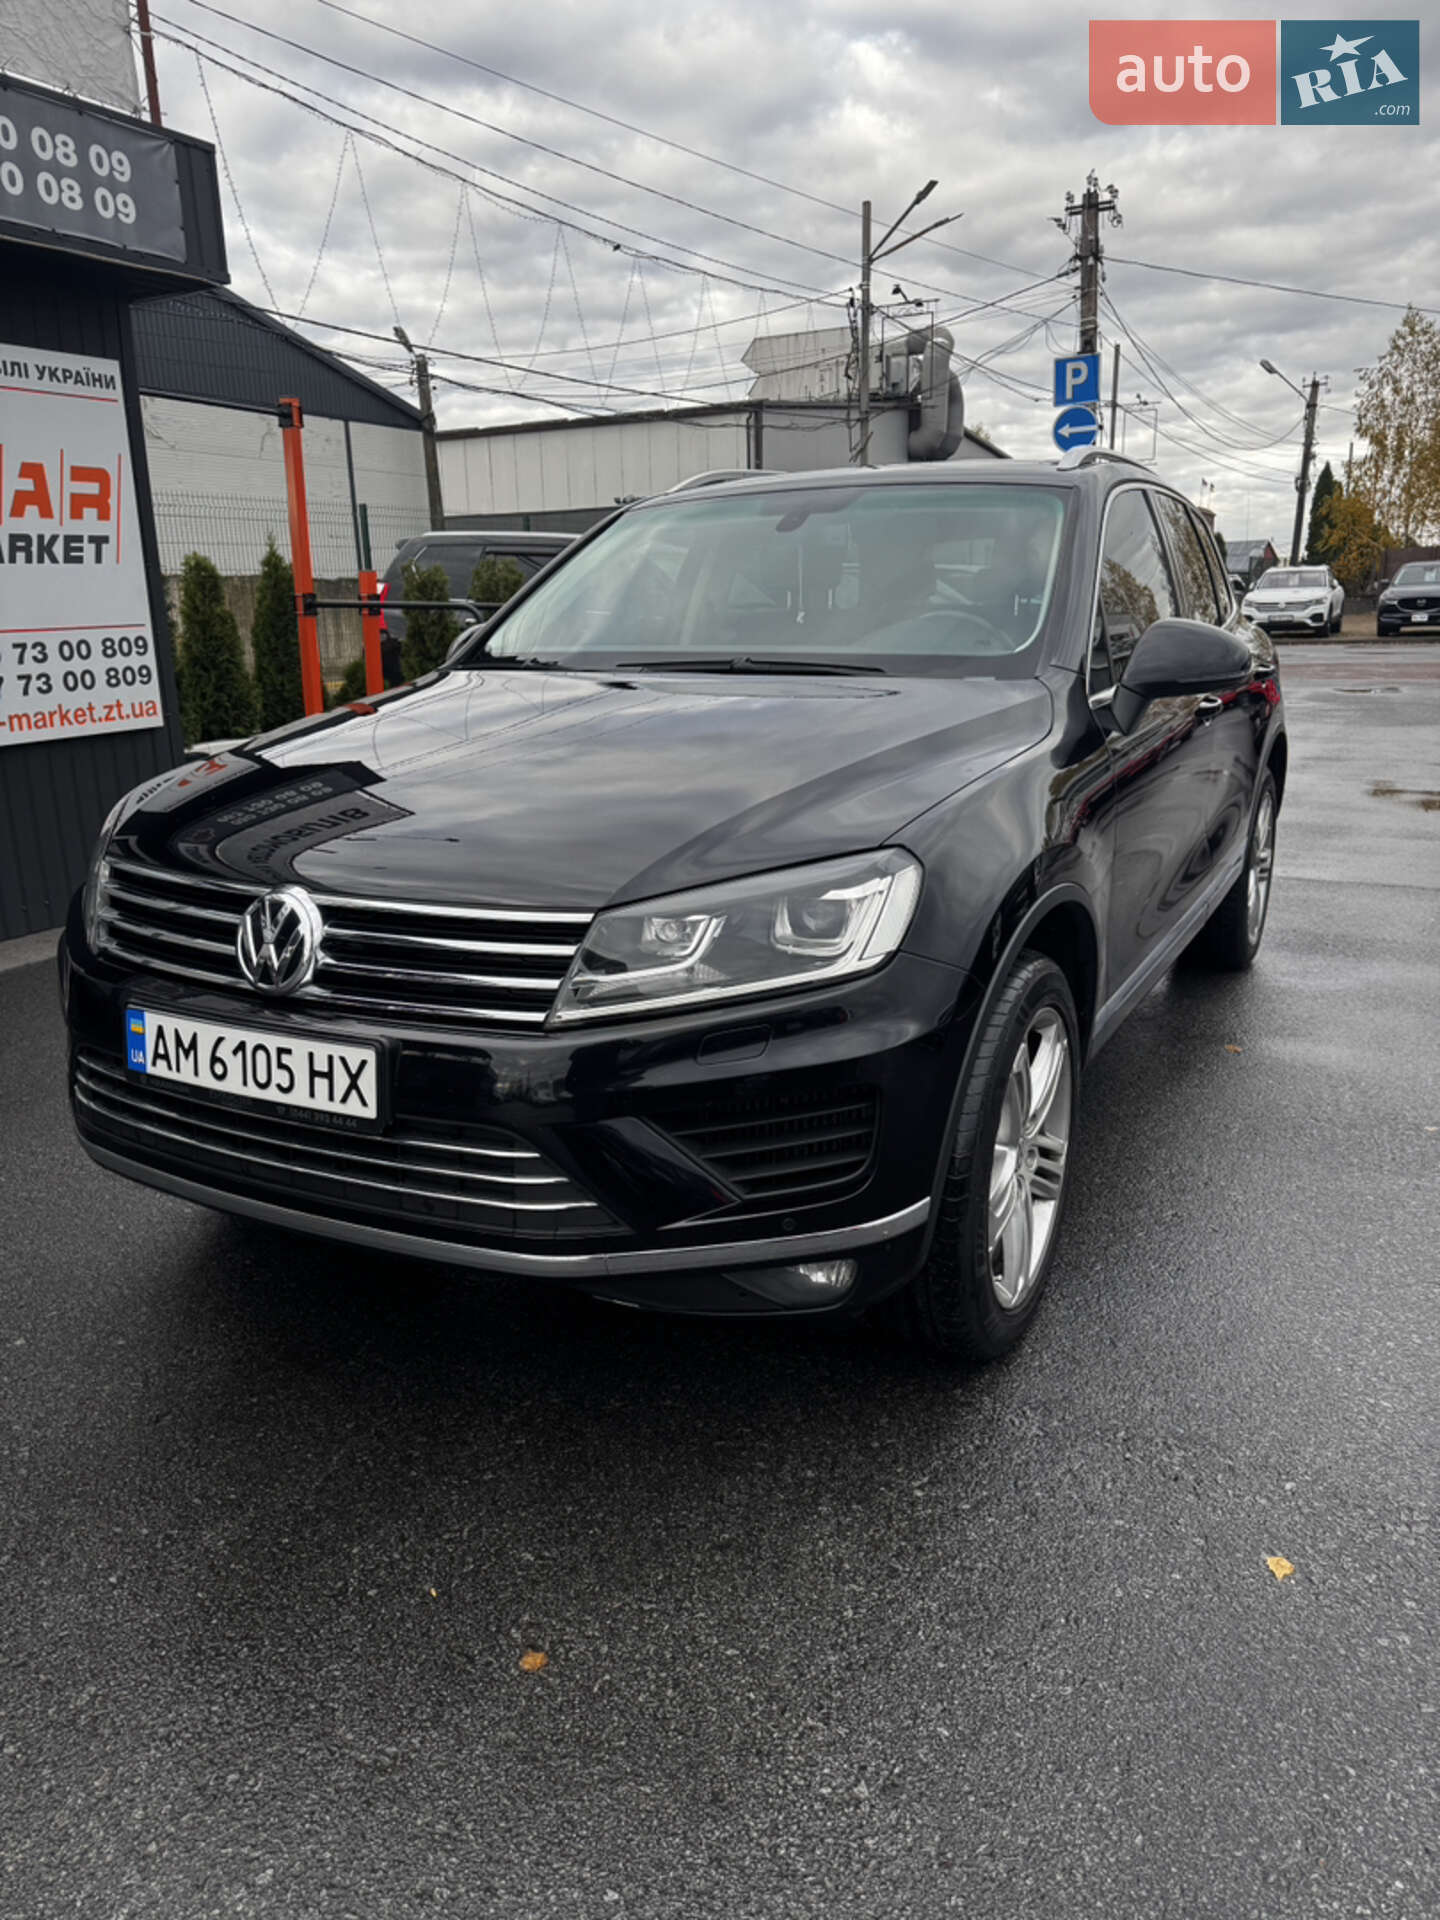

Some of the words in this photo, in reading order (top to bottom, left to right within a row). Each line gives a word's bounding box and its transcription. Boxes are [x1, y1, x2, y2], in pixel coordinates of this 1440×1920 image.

[30, 126, 78, 168] 08
[89, 143, 132, 182] 09
[1, 161, 24, 196] 0
[37, 171, 84, 210] 08
[94, 187, 137, 224] 09
[0, 360, 29, 379] ІЛІ
[34, 364, 117, 390] УКРАЇНИ
[1066, 361, 1088, 400] P
[0, 533, 109, 564] RKET
[12, 642, 48, 665] 73
[58, 639, 92, 662] 00
[101, 635, 148, 658] 809
[17, 673, 53, 696] 73
[63, 669, 96, 692] 00
[105, 665, 152, 688] 809
[131, 1049, 145, 1064] UA
[151, 1024, 200, 1077] AM
[210, 1036, 295, 1094] 6105
[308, 1051, 369, 1108] HX
